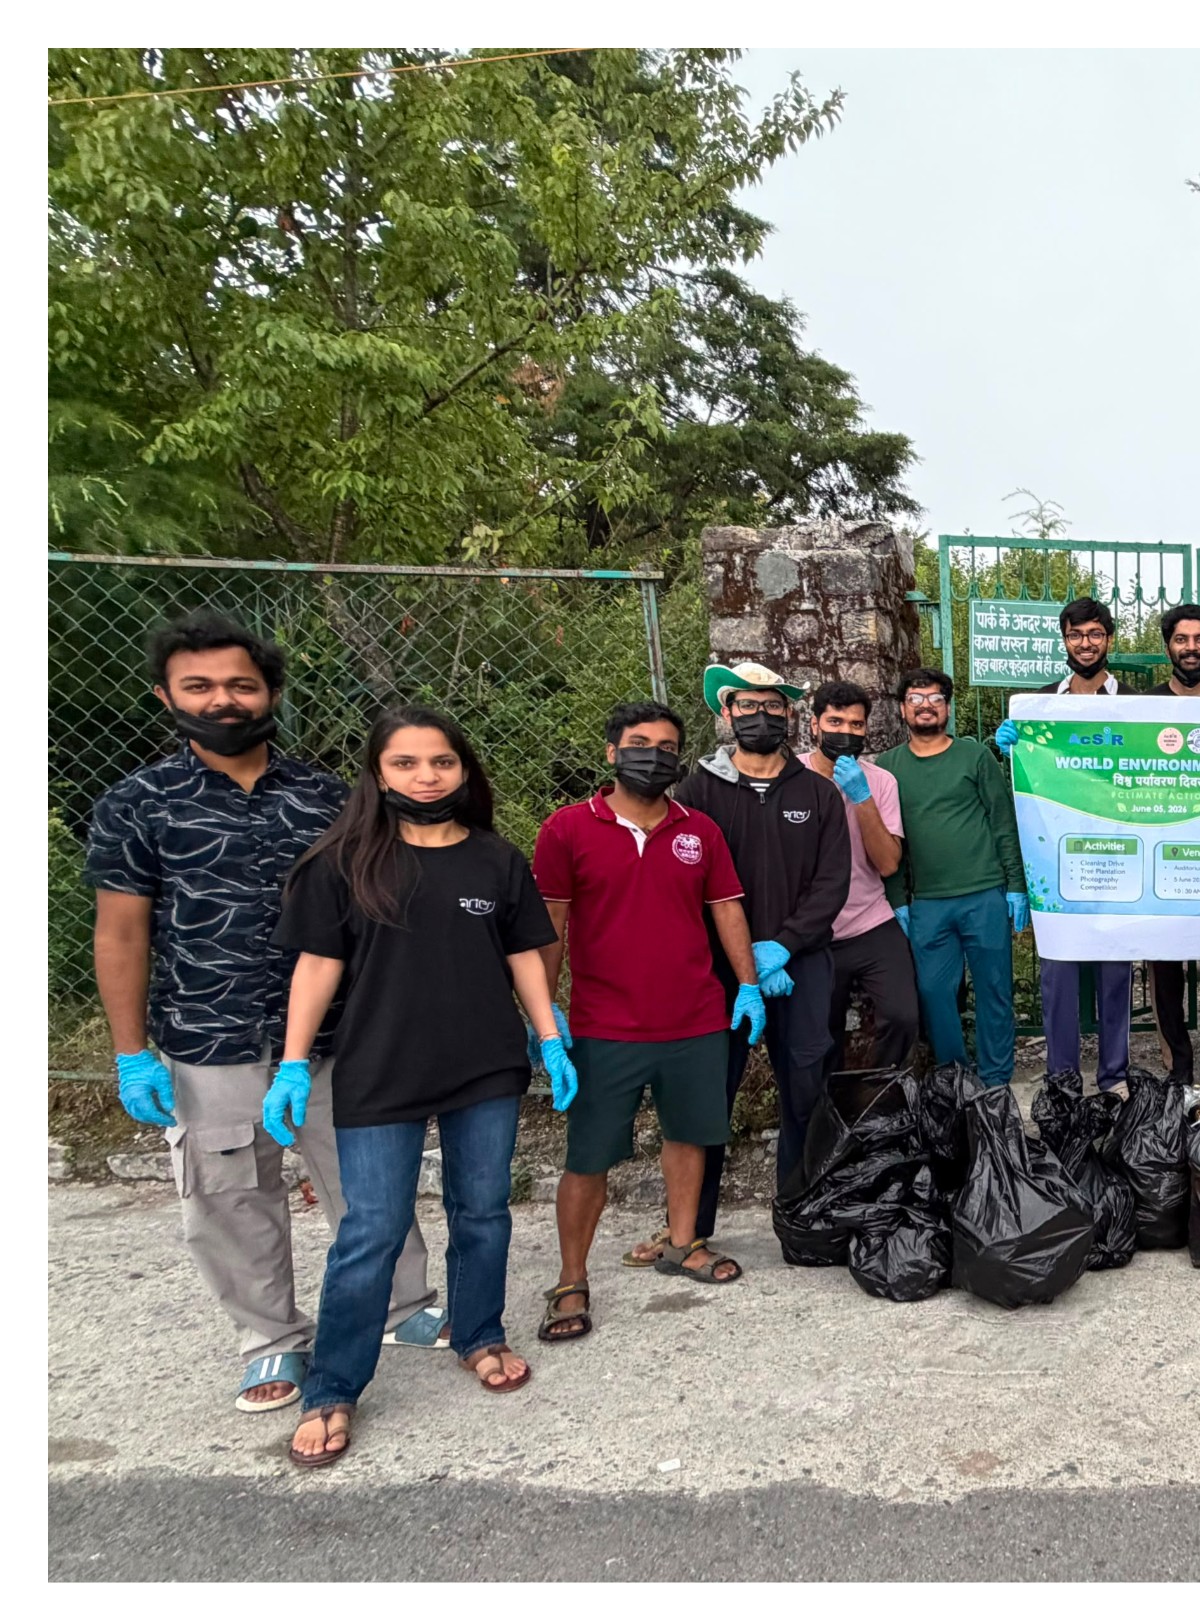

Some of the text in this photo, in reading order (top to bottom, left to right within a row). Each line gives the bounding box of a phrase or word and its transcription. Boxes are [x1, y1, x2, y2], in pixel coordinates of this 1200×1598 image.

[975, 605, 997, 629] पार्क
[999, 607, 1011, 630] के
[1032, 638, 1055, 654] मना
[1055, 756, 1114, 770] WORLD
[1112, 773, 1133, 787] विश्व
[1135, 773, 1177, 788] पर्यावरण
[1131, 804, 1152, 813] June
[1168, 805, 1188, 813] 2026
[1084, 841, 1126, 851] Activities
